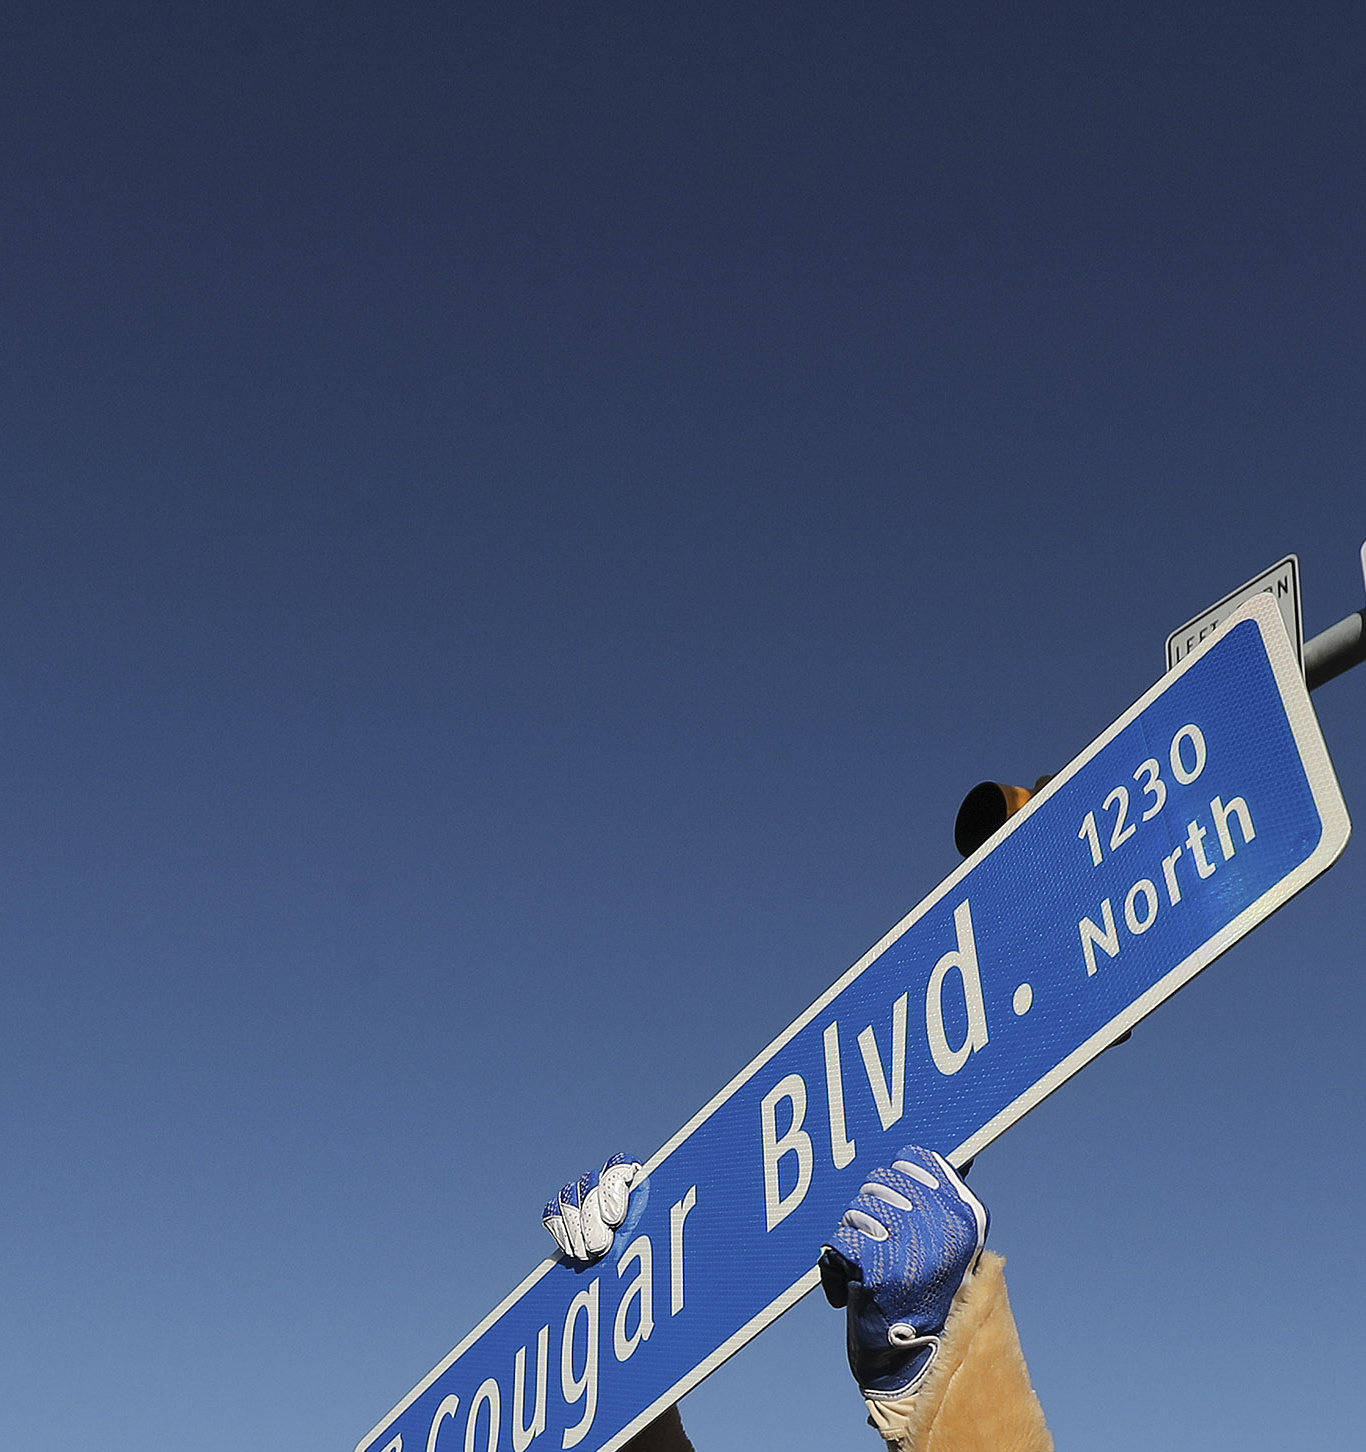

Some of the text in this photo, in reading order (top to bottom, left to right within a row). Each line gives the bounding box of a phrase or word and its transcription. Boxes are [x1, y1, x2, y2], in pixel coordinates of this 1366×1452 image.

[1077, 723, 1208, 867] 1230
[1078, 795, 1257, 977] North
[760, 897, 1034, 1233] Blvd.
